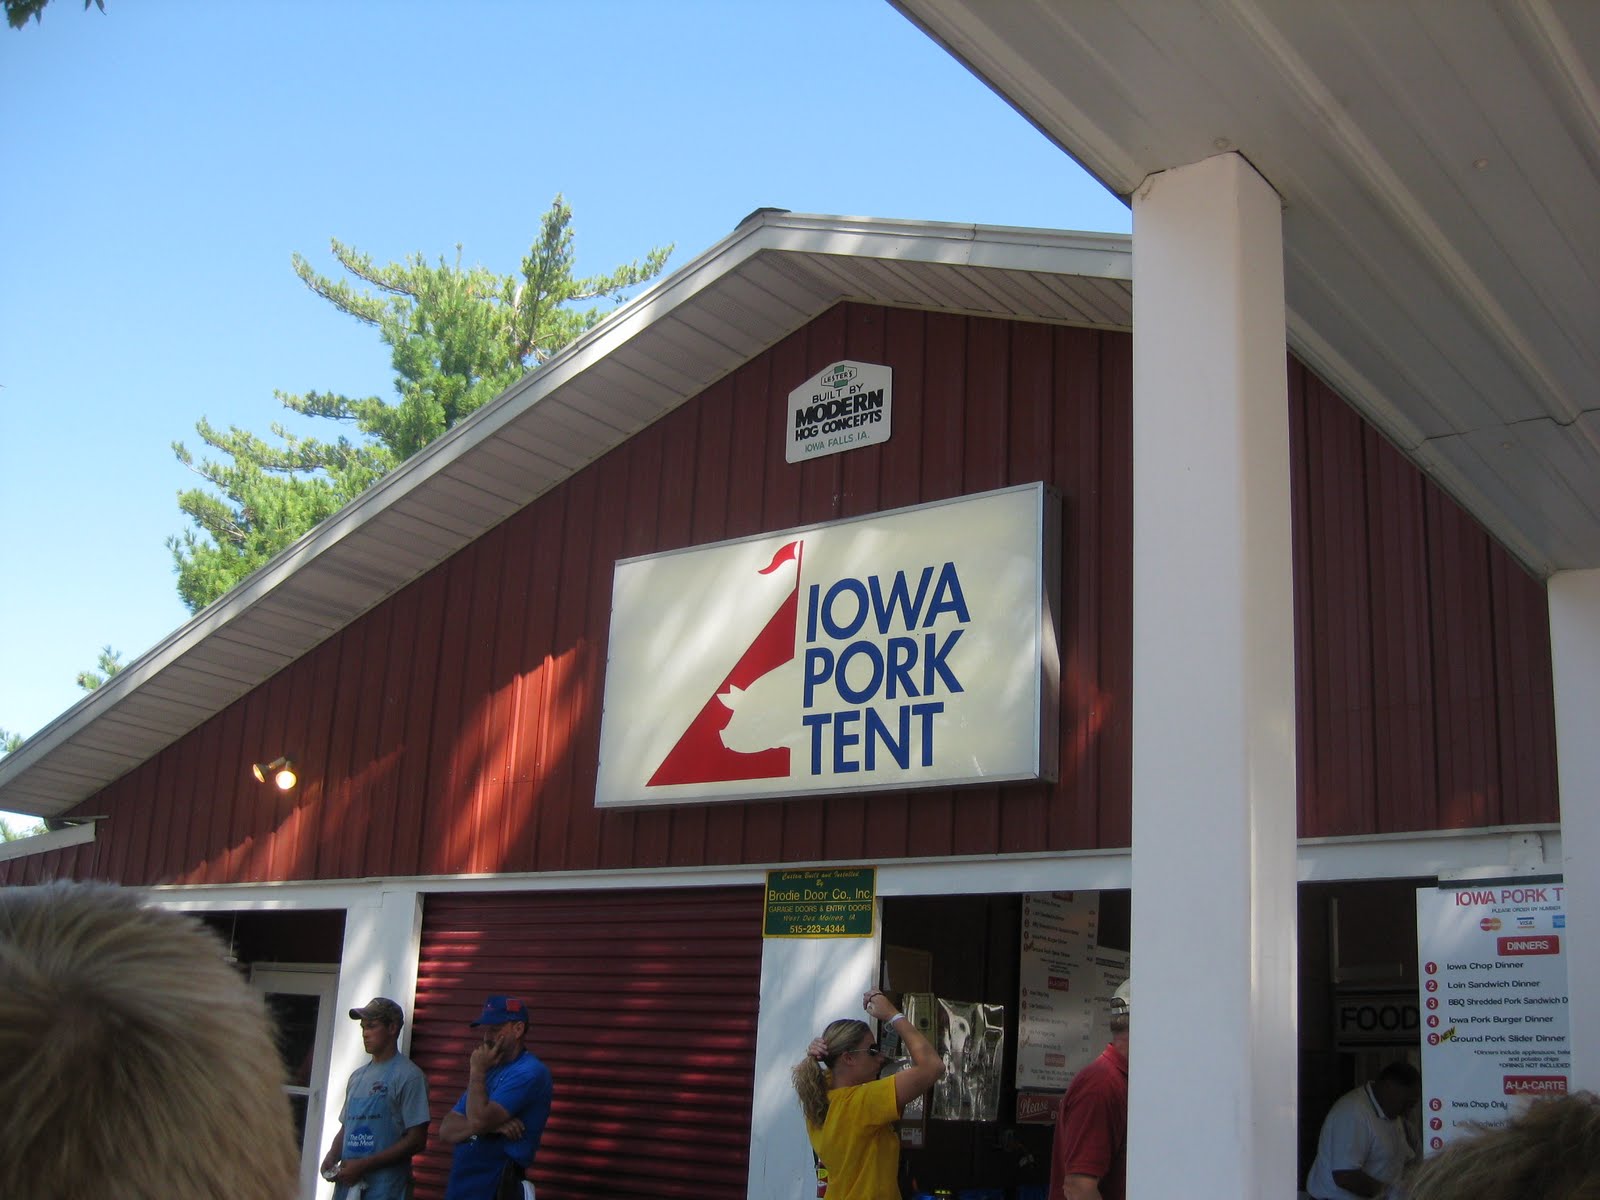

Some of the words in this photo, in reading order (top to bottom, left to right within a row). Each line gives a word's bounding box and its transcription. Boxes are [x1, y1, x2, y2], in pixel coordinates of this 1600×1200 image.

[824, 370, 852, 384] LESTER'S
[812, 388, 842, 404] BUILT
[850, 383, 864, 394] BY
[796, 388, 884, 428] MODERN
[795, 425, 818, 441] HOG
[822, 410, 882, 434] CONCEPTS
[805, 441, 824, 452] IOWA
[806, 562, 970, 642] IOWA
[803, 630, 964, 708] PORK
[802, 702, 944, 775] TENT
[768, 890, 800, 901] Brodie
[804, 889, 828, 900] Door
[855, 888, 873, 899] Inc.
[1456, 890, 1496, 906] IOWA
[1501, 888, 1548, 904] PORK
[826, 904, 846, 912] ENTRY
[848, 904, 872, 912] DOORS
[790, 924, 846, 934] 515-223-4344
[1506, 940, 1549, 950] DINNERS
[1469, 962, 1492, 971] Chop
[1468, 980, 1510, 988] Sandwich
[1512, 980, 1540, 988] Dinner
[1448, 998, 1465, 1007] BBQ
[1467, 998, 1504, 1006] Shredded
[1448, 1016, 1468, 1024] Iowa
[1493, 1016, 1522, 1024] Burger
[1440, 1027, 1456, 1042] NEW
[1508, 1034, 1533, 1042] Slider
[1536, 1034, 1566, 1042] Dinner
[1506, 1081, 1565, 1090] A-LA-CARTE
[1020, 1098, 1049, 1116] Please
[1470, 1100, 1490, 1109] Chop
[1491, 1100, 1508, 1110] Only
